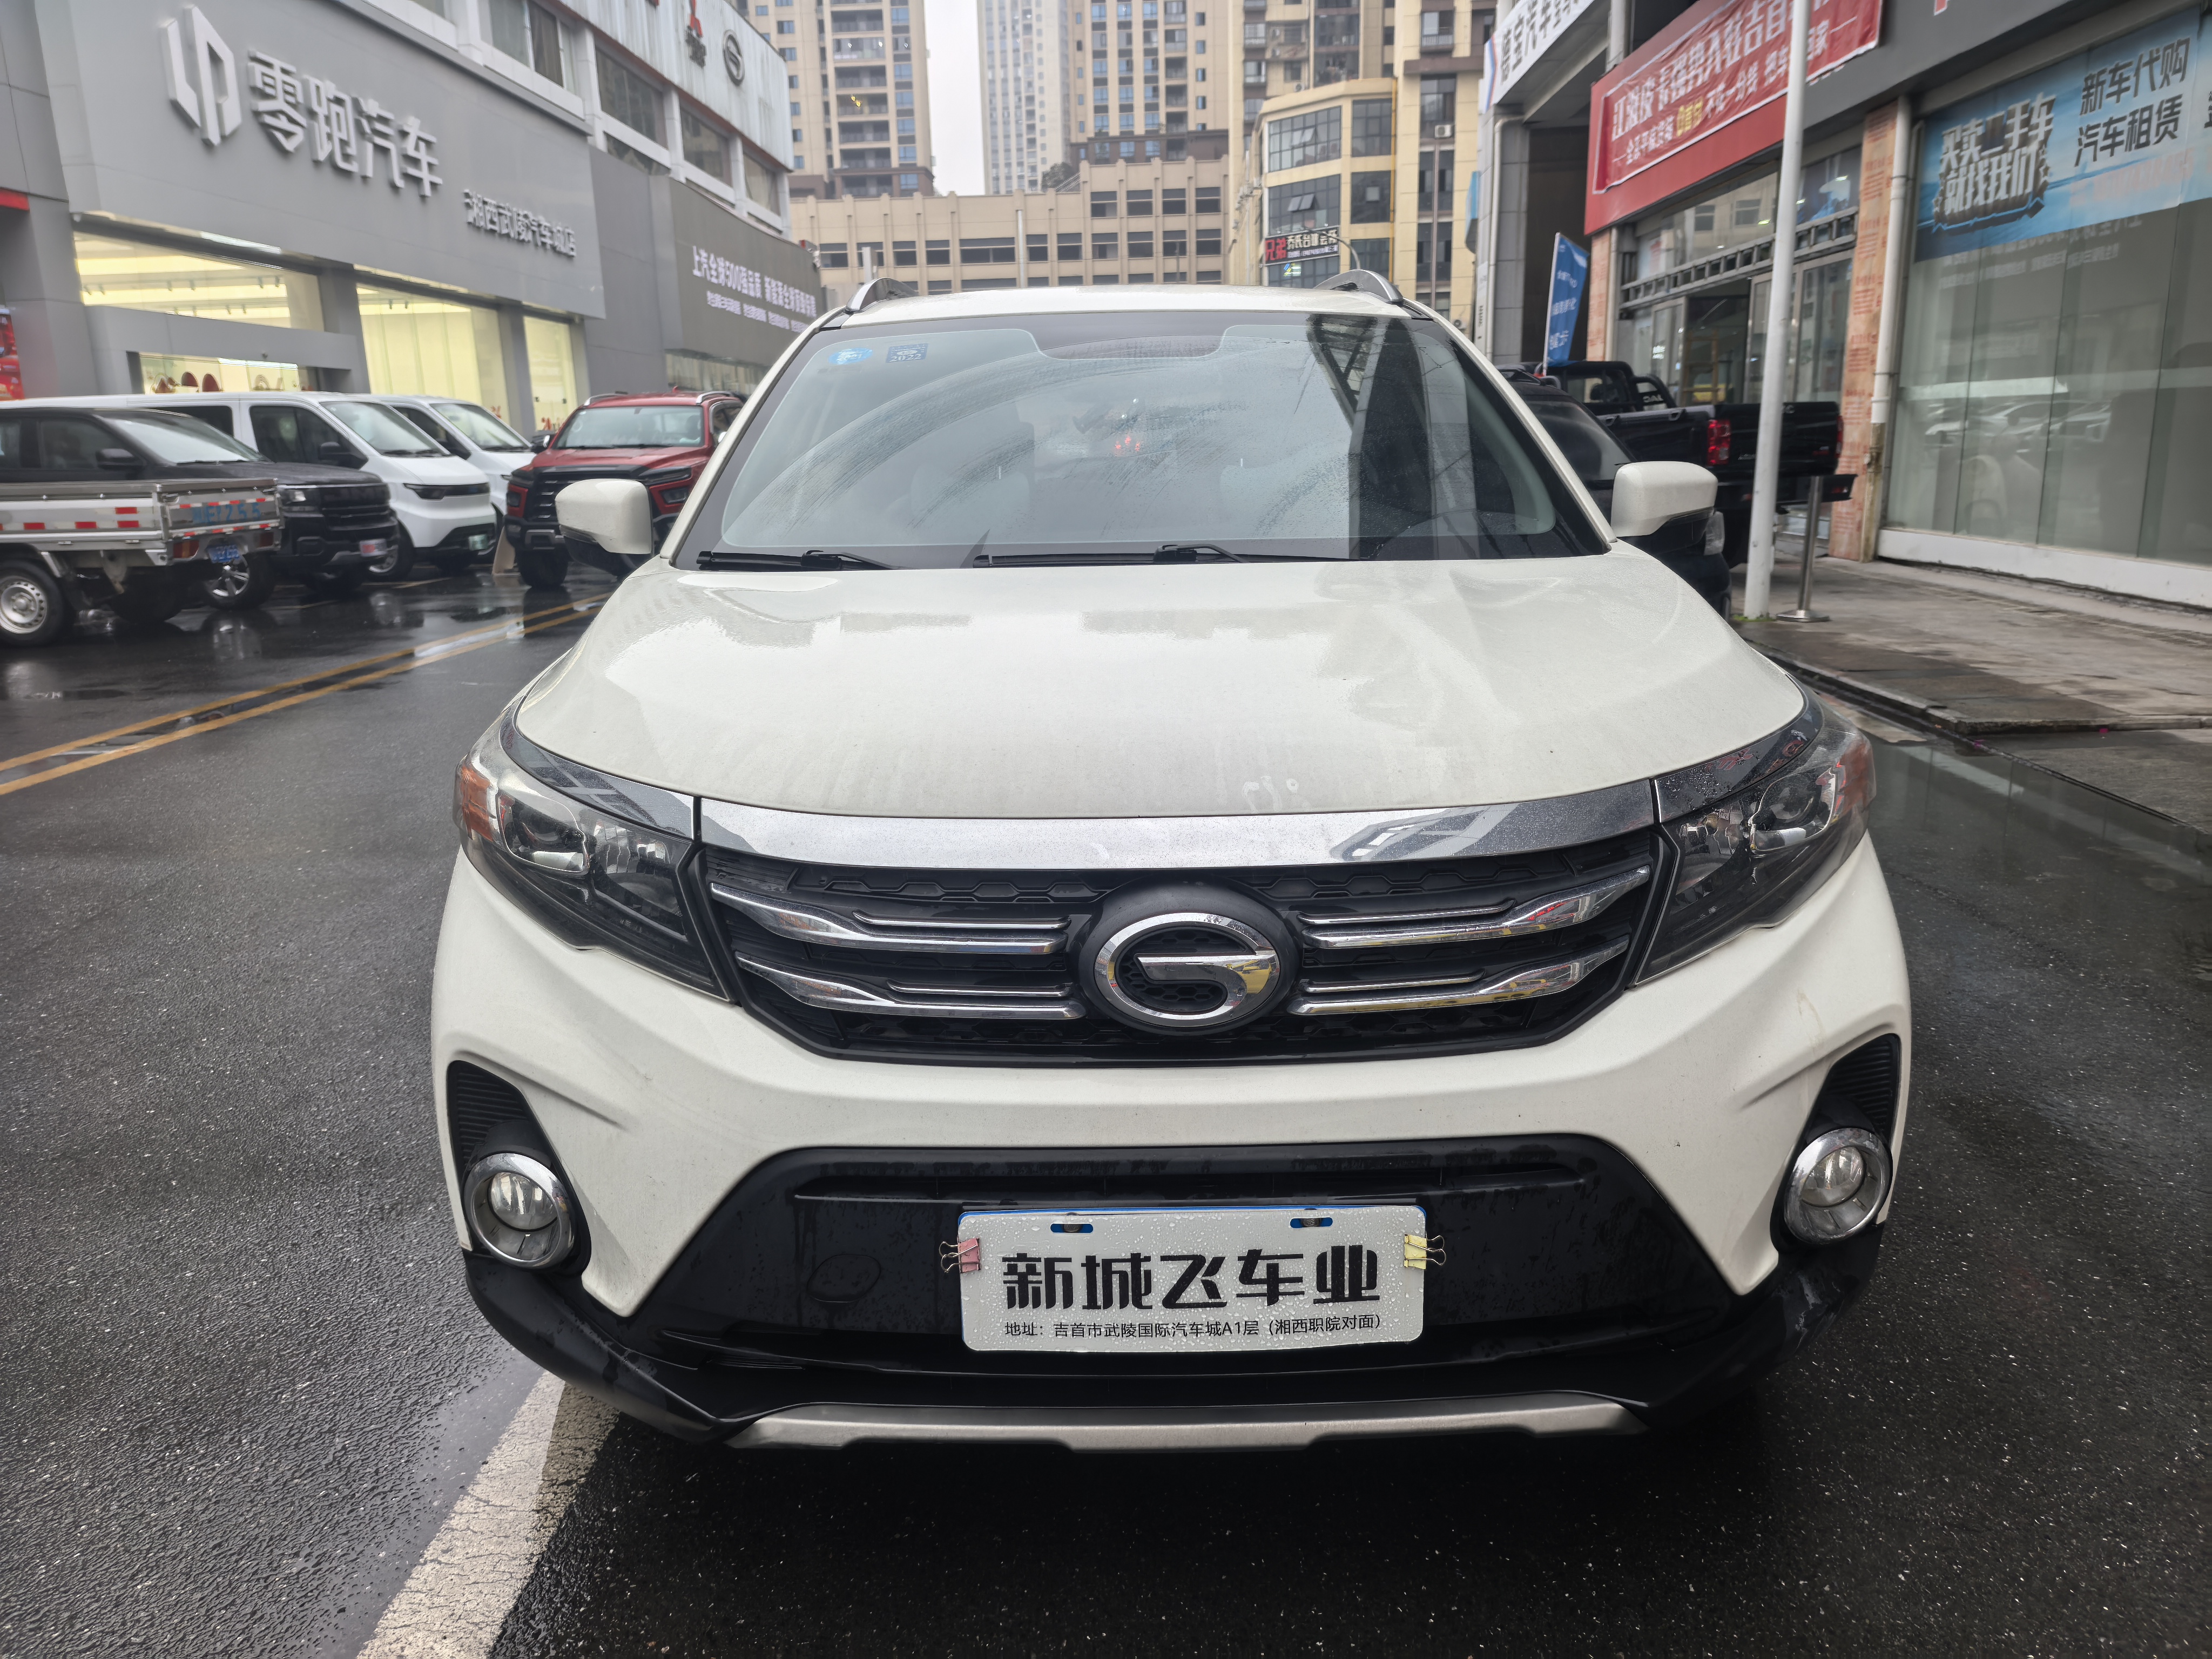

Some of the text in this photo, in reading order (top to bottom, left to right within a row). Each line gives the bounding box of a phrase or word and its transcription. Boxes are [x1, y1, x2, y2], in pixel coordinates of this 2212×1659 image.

[1764, 19, 1830, 86] 把车家
[2080, 37, 2190, 116] 新车代购
[248, 48, 443, 197] 零跑汽车
[1941, 92, 2056, 174] 买卖二手车
[2074, 94, 2183, 167] 汽车租赁
[1944, 141, 2040, 215] 就找我们
[463, 189, 576, 257] 湘西武陵汽车城店
[1265, 237, 1286, 261] 兄弟
[889, 354, 921, 362] 2022
[1002, 1245, 1380, 1310] 新城飞车业
